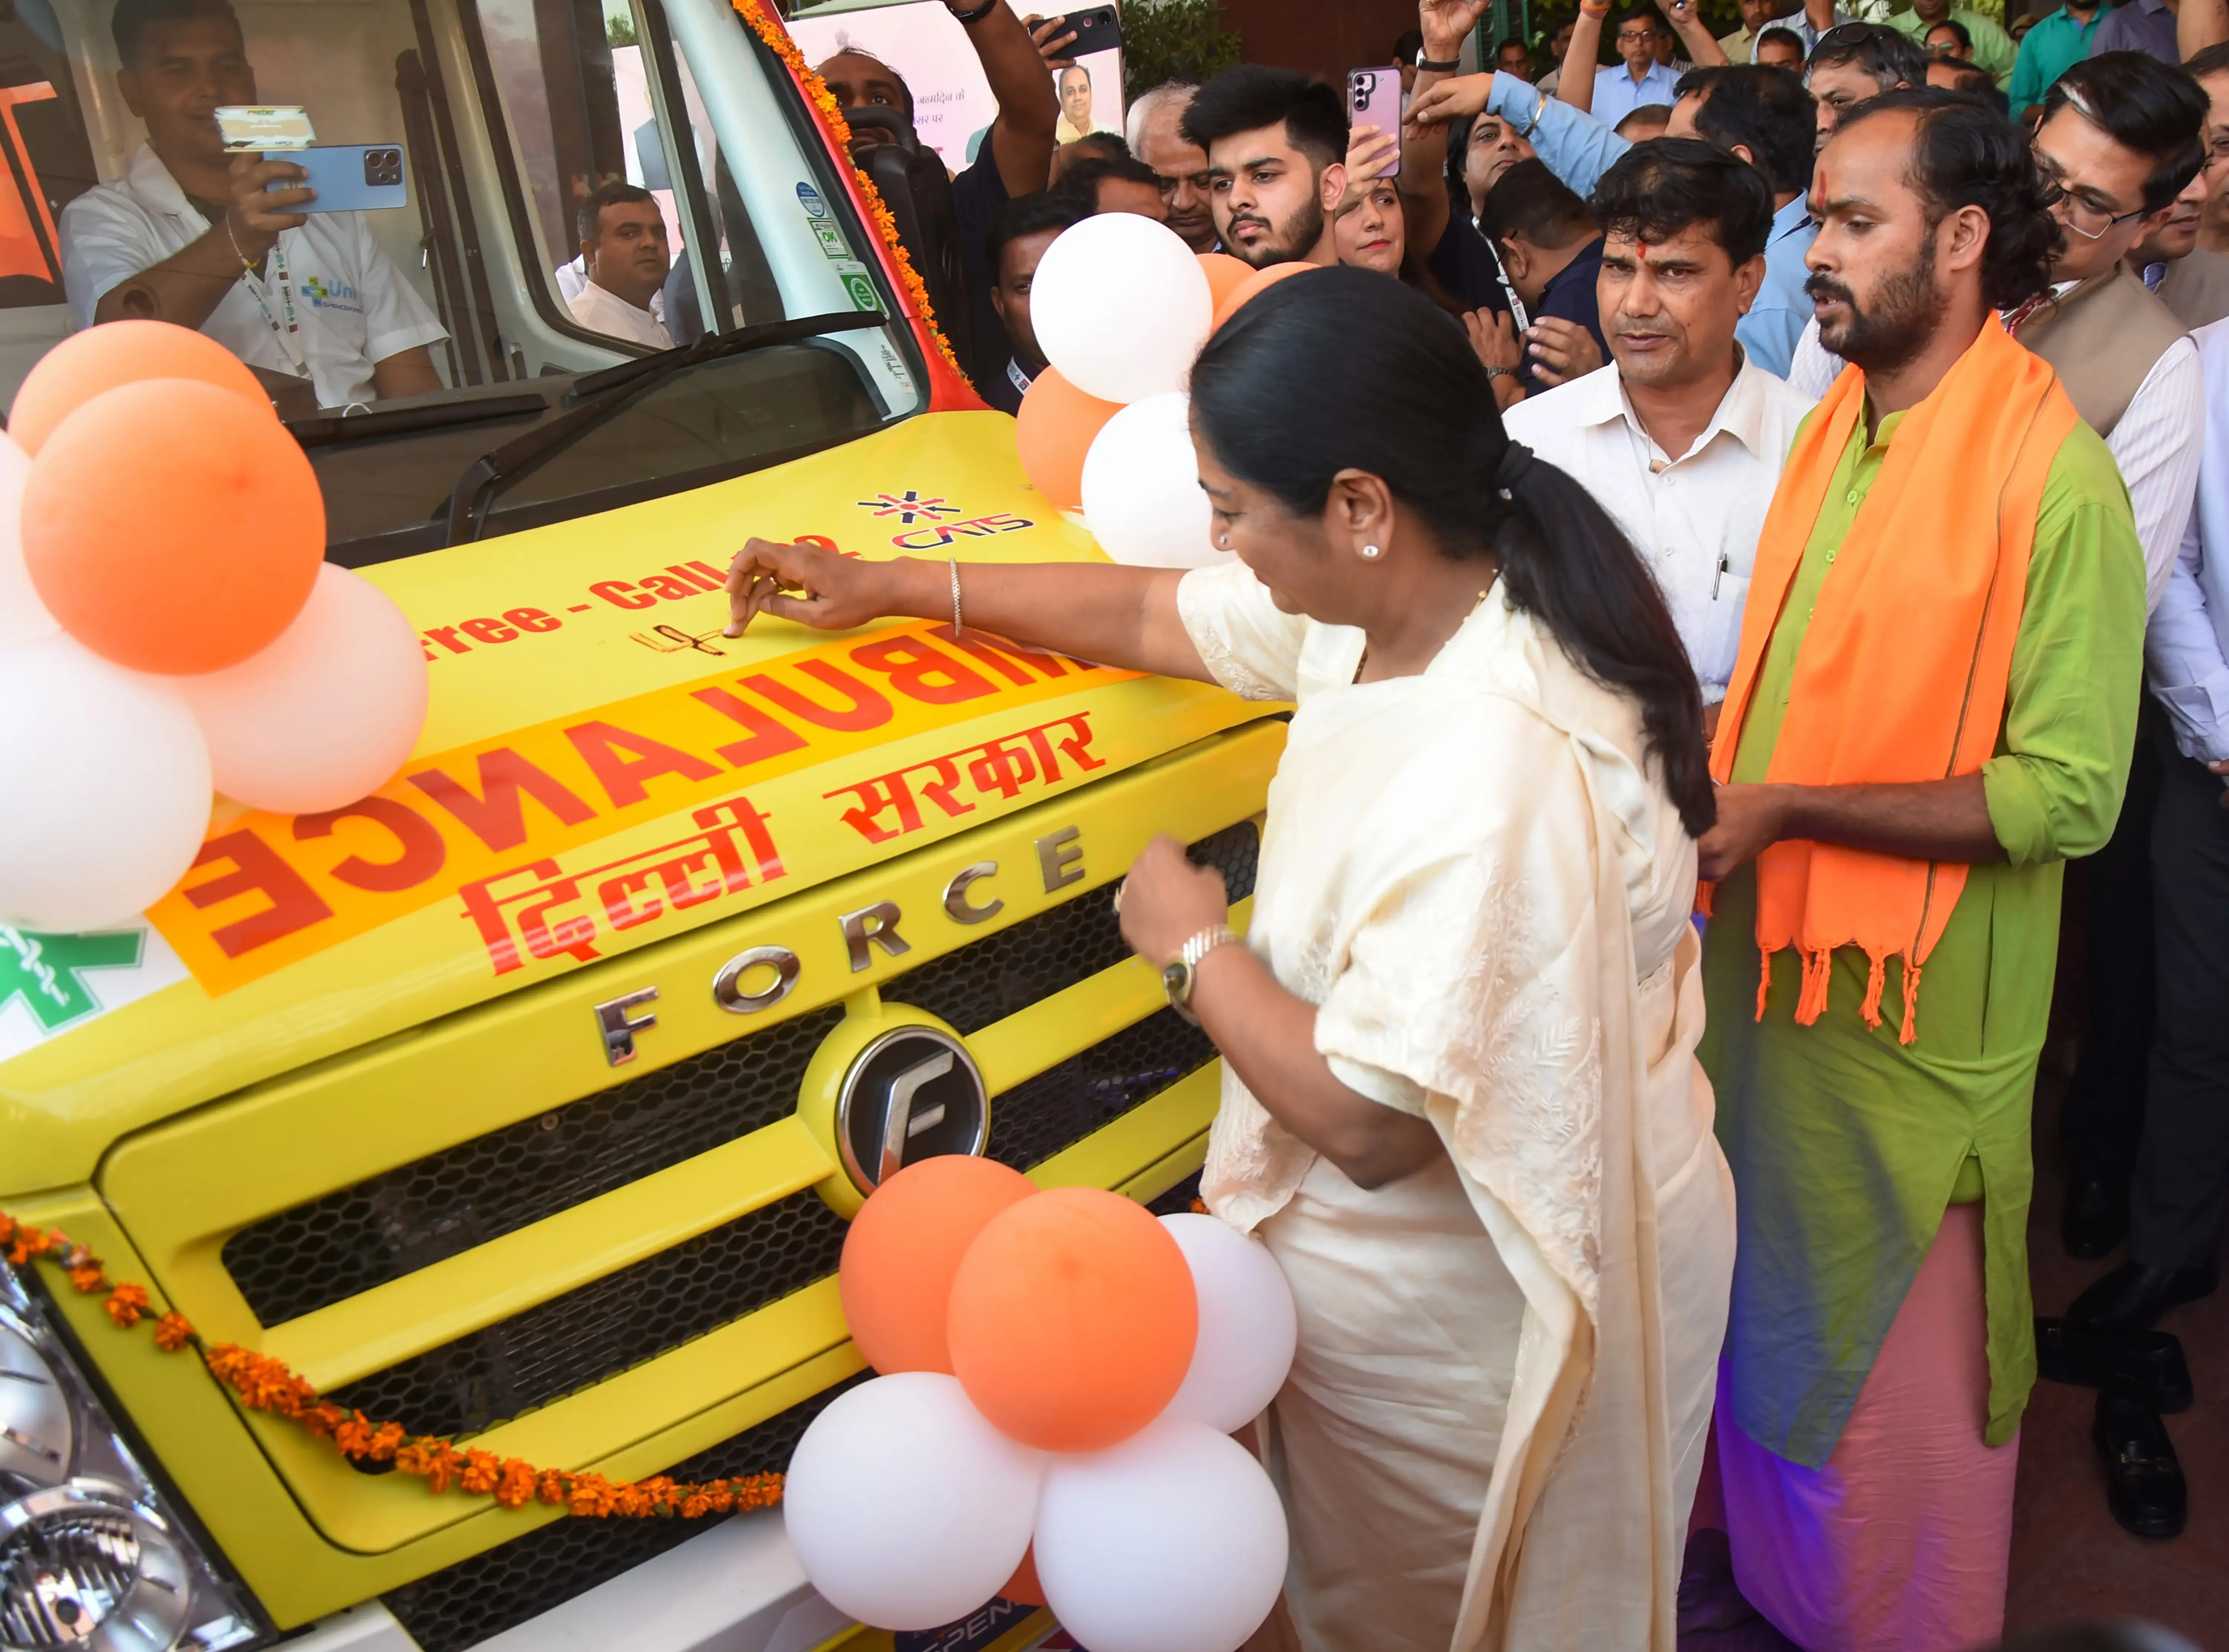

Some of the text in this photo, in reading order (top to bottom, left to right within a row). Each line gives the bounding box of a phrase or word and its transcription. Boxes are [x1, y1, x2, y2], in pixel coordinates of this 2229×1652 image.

[932, 114, 944, 123] पर
[822, 232, 837, 242] OK
[892, 513, 1034, 549] CATS
[424, 607, 562, 661] ree
[589, 560, 729, 609] Call
[459, 711, 1106, 977] दिल्ली सरकार
[594, 824, 1086, 1067] FORCE
